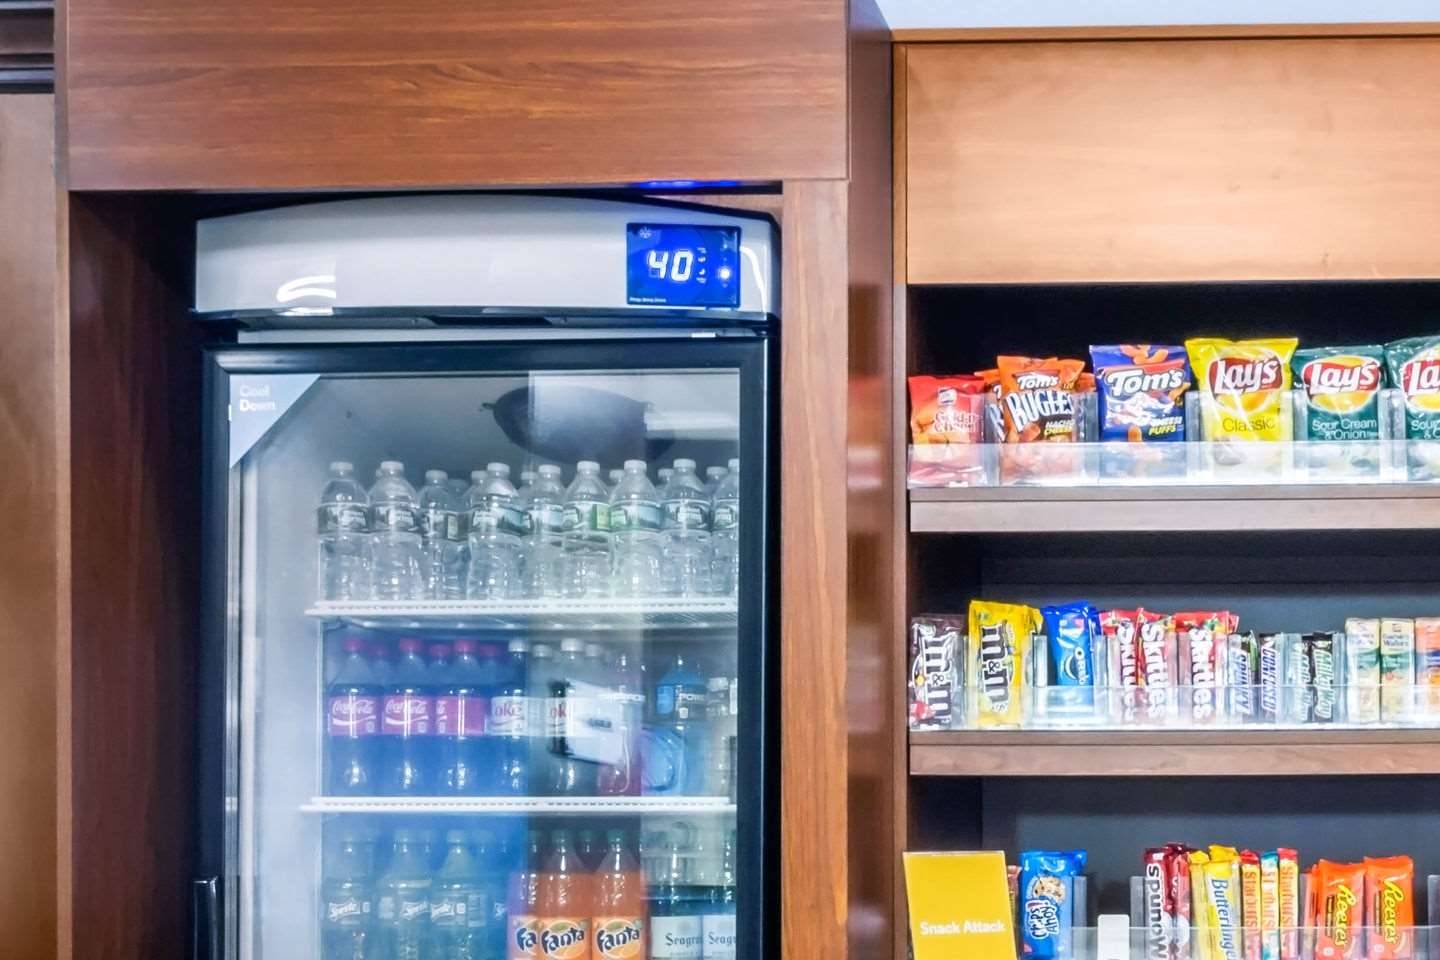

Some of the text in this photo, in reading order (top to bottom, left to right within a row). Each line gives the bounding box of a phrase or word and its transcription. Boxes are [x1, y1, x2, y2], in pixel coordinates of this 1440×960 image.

[648, 249, 694, 282] 40
[1107, 370, 1183, 396] Tom's
[1214, 357, 1278, 394] Lay's
[1310, 362, 1374, 394] Lay's
[1333, 428, 1367, 440] Onion
[1341, 418, 1377, 428] Cream
[1141, 622, 1168, 720] Skittles
[1188, 626, 1214, 720] Skittles
[920, 920, 1005, 934] Snack Attack
[1148, 864, 1169, 960] Mounds
[1335, 885, 1356, 946] Reese's
[1383, 879, 1404, 944] Reese's
[541, 926, 585, 954] Fanta
[597, 926, 640, 953] Fanta
